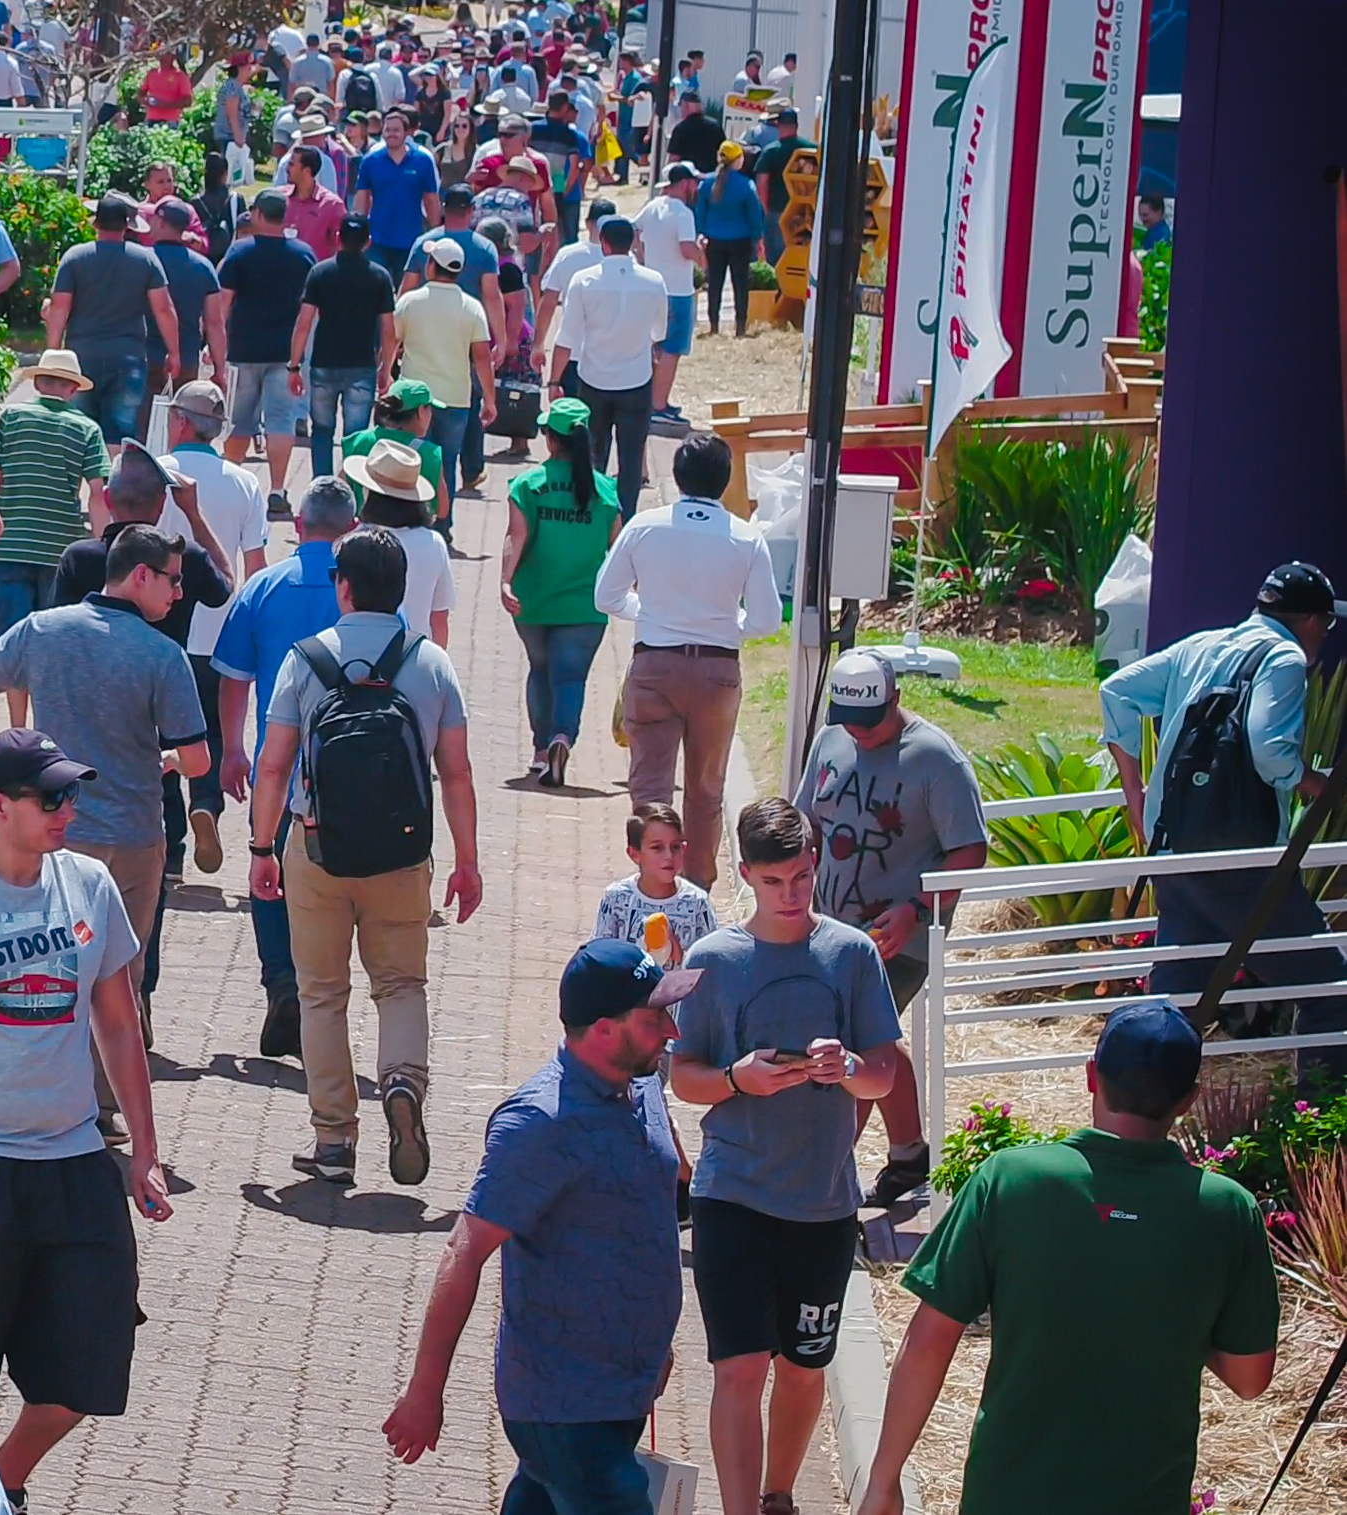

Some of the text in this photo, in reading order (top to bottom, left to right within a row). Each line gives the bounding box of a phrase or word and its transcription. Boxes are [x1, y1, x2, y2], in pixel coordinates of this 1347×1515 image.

[1099, 105, 1116, 232] TECNOLOGIA
[955, 104, 985, 299] PIRATINI
[830, 682, 865, 699] Hurley
[16, 932, 50, 960] DO
[49, 926, 76, 952] IT.
[797, 1302, 839, 1334] RC
